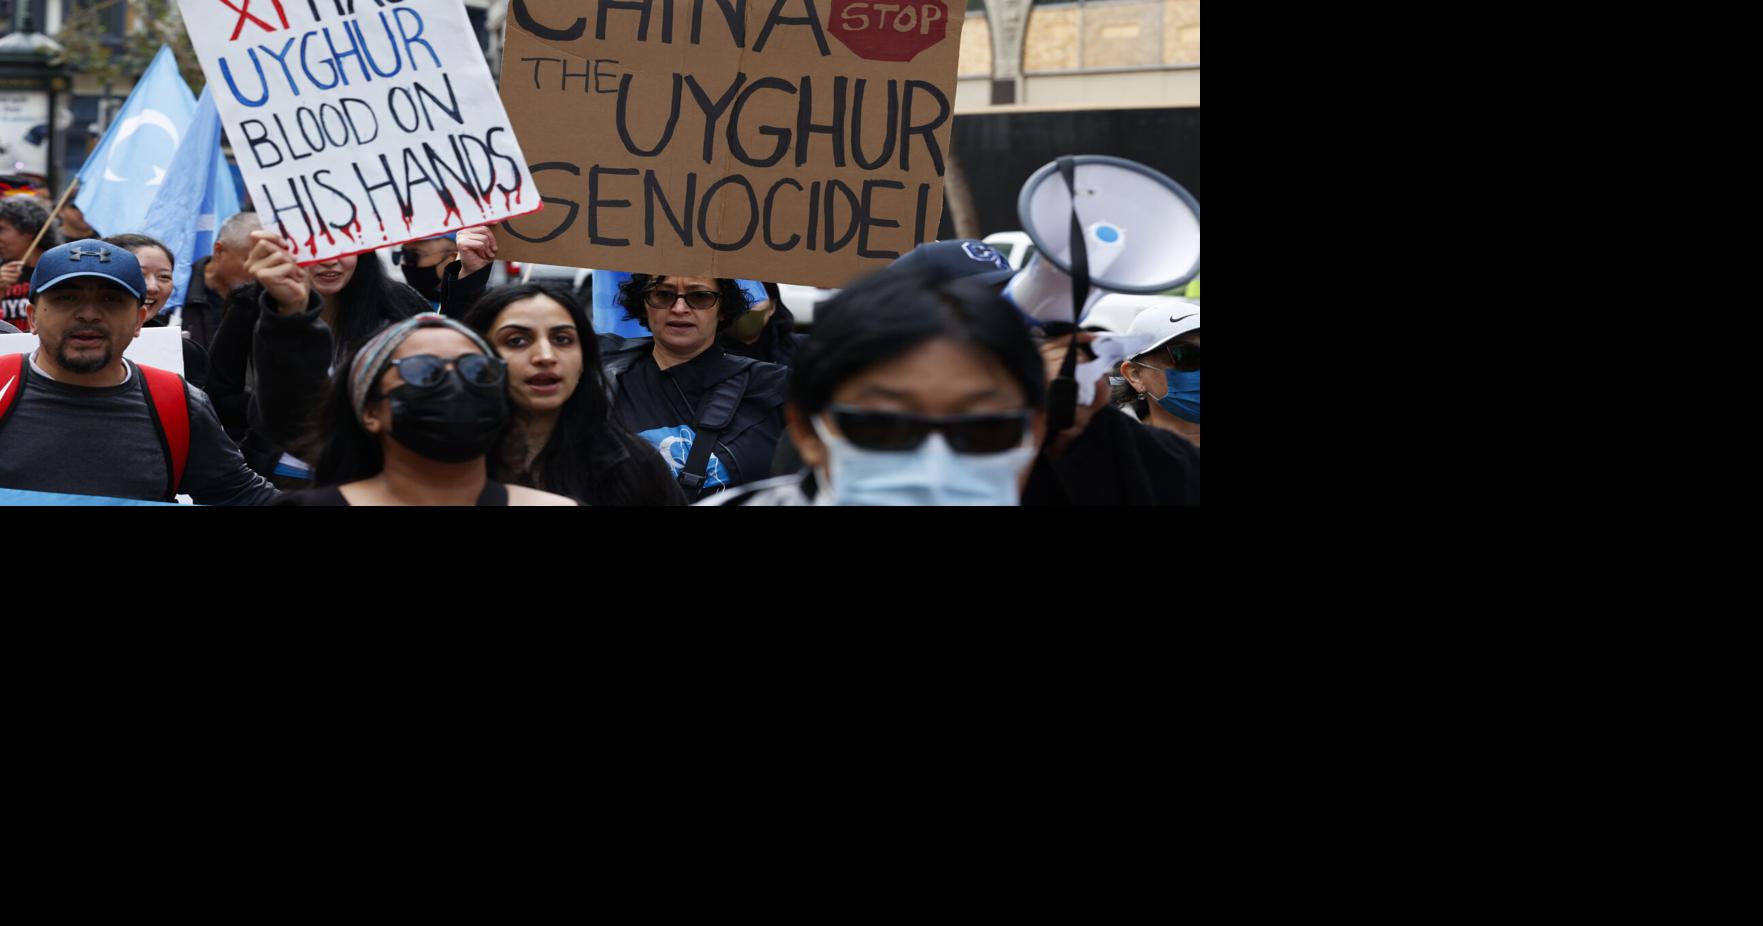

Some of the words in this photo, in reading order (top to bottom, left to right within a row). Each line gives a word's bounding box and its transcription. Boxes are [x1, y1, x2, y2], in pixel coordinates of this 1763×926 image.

[218, 7, 442, 107] UYGHUR
[841, 3, 942, 35] STOP
[240, 98, 378, 168] BLOOD
[388, 73, 464, 132] ON
[521, 57, 619, 93] THE
[616, 72, 949, 176] UYGHUR
[262, 170, 359, 246] HIS
[352, 127, 522, 226] HANDS
